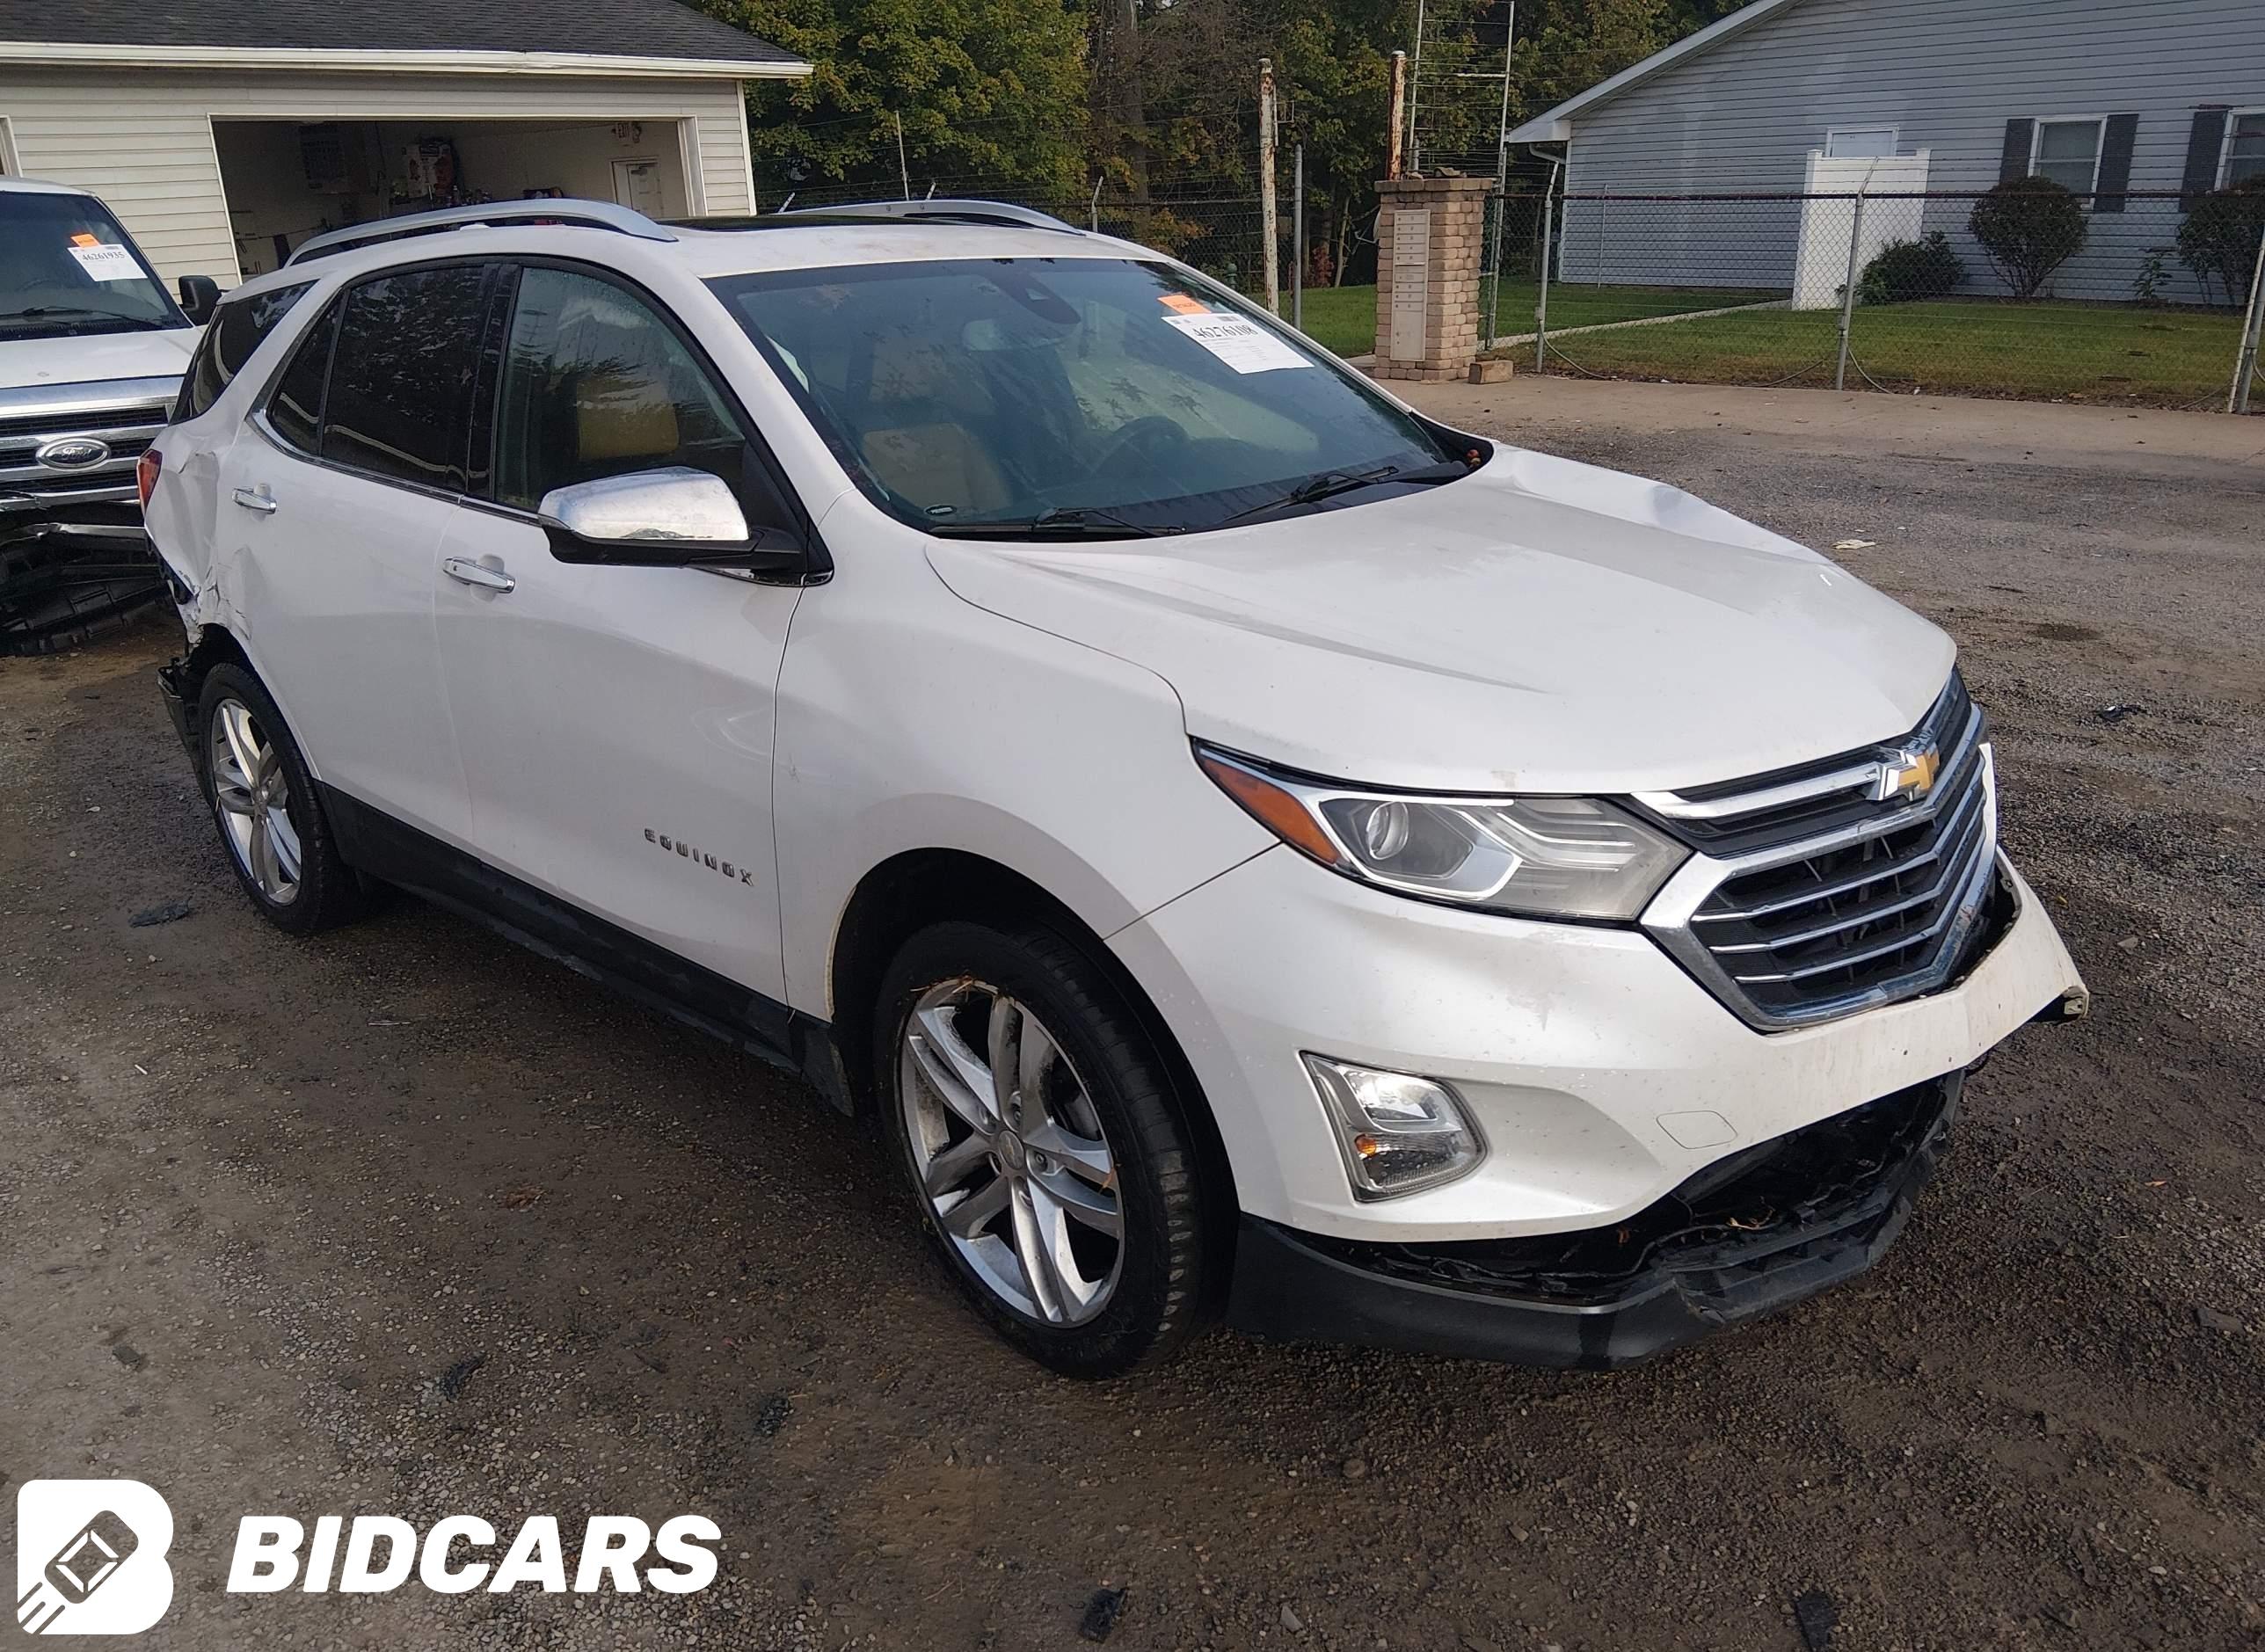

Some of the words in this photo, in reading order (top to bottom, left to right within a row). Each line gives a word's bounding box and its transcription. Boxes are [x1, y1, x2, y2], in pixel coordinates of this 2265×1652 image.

[82, 251, 125, 261] 46261935
[1191, 324, 1259, 338] 46276108
[644, 827, 754, 887] EQUINOX
